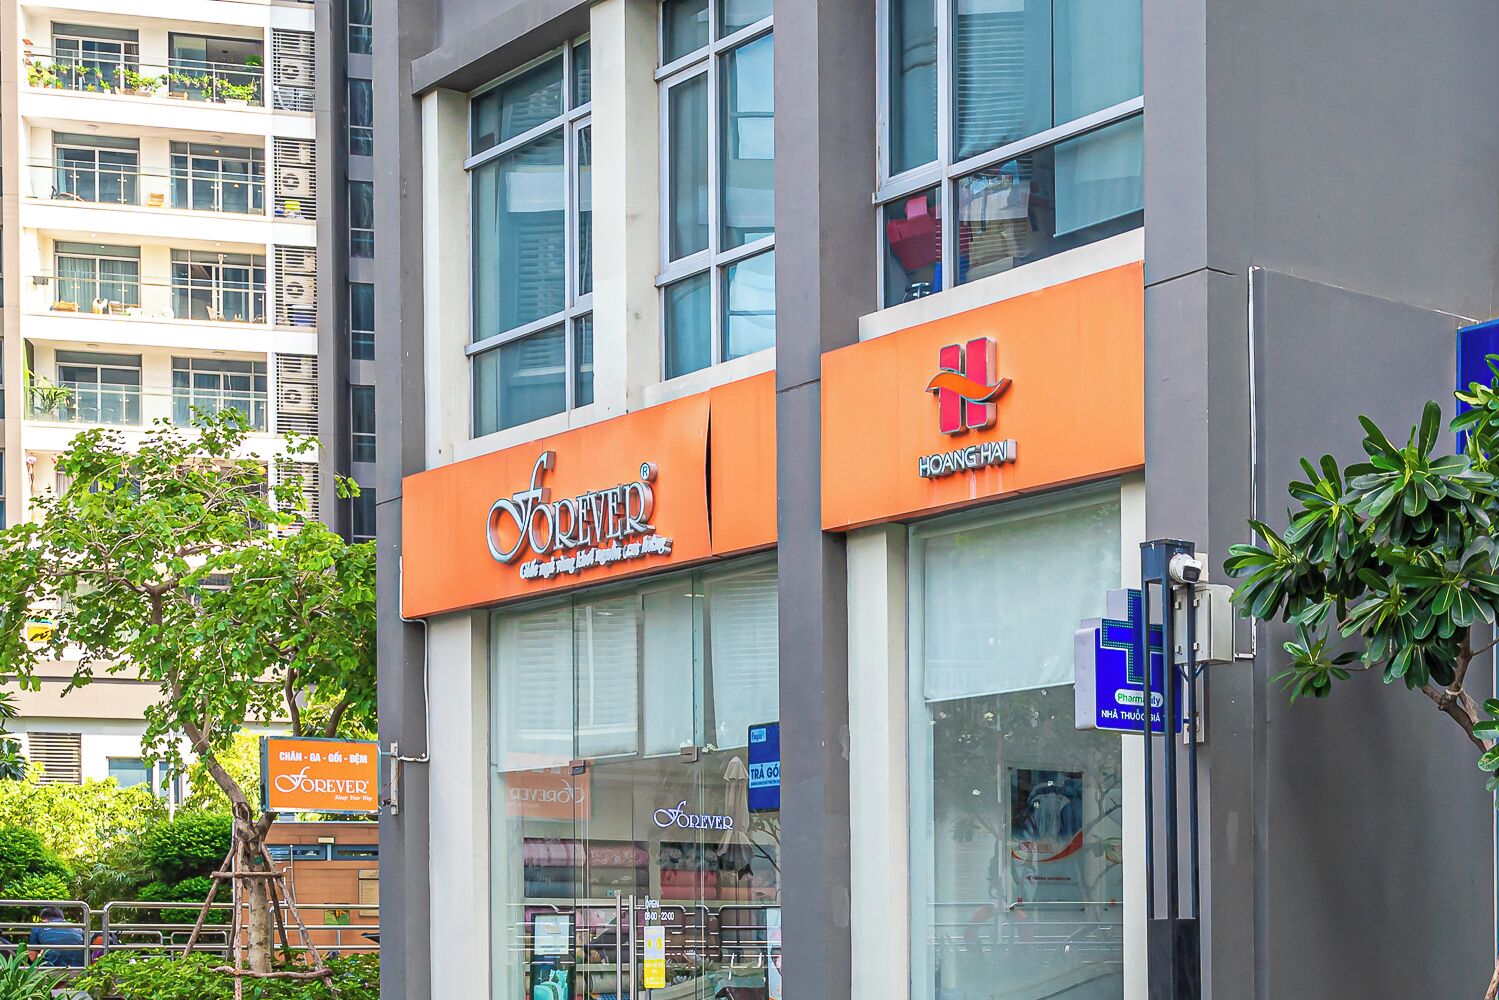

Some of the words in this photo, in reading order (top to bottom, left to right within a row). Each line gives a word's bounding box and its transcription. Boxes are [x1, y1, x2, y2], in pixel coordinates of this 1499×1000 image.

[918, 446, 977, 477] HOANG
[979, 439, 1012, 466] HAI
[1101, 708, 1119, 719] NHÀ
[279, 750, 302, 761] CHĂN
[751, 764, 765, 780] TRẢ
[766, 763, 780, 779] GÓ
